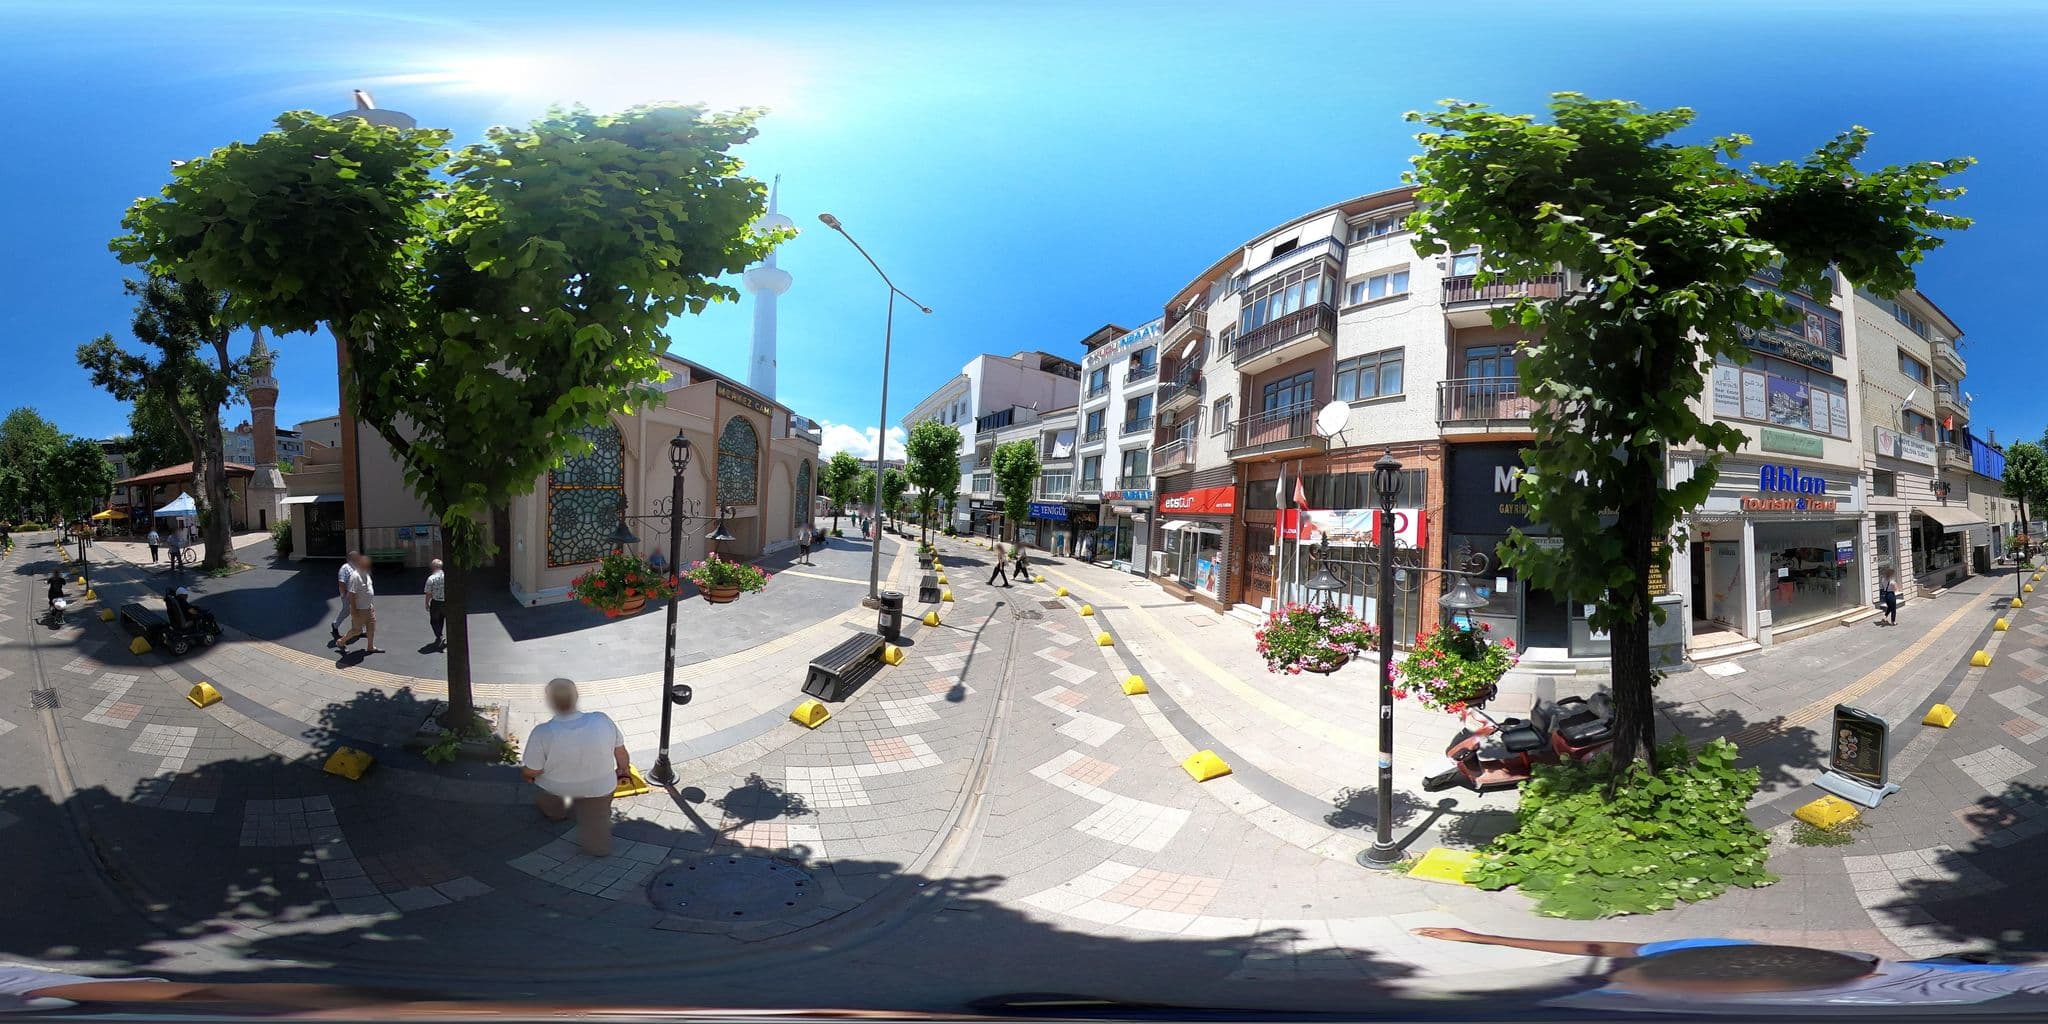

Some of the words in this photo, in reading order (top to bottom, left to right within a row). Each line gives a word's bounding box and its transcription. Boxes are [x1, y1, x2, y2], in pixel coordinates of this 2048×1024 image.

[1760, 464, 1825, 495] Ahlan
[1165, 496, 1194, 508] etstur
[1740, 496, 1793, 512] Tourism
[1796, 497, 1807, 512] &
[1806, 496, 1837, 512] Travel
[1040, 506, 1067, 516] YENİGÜL
